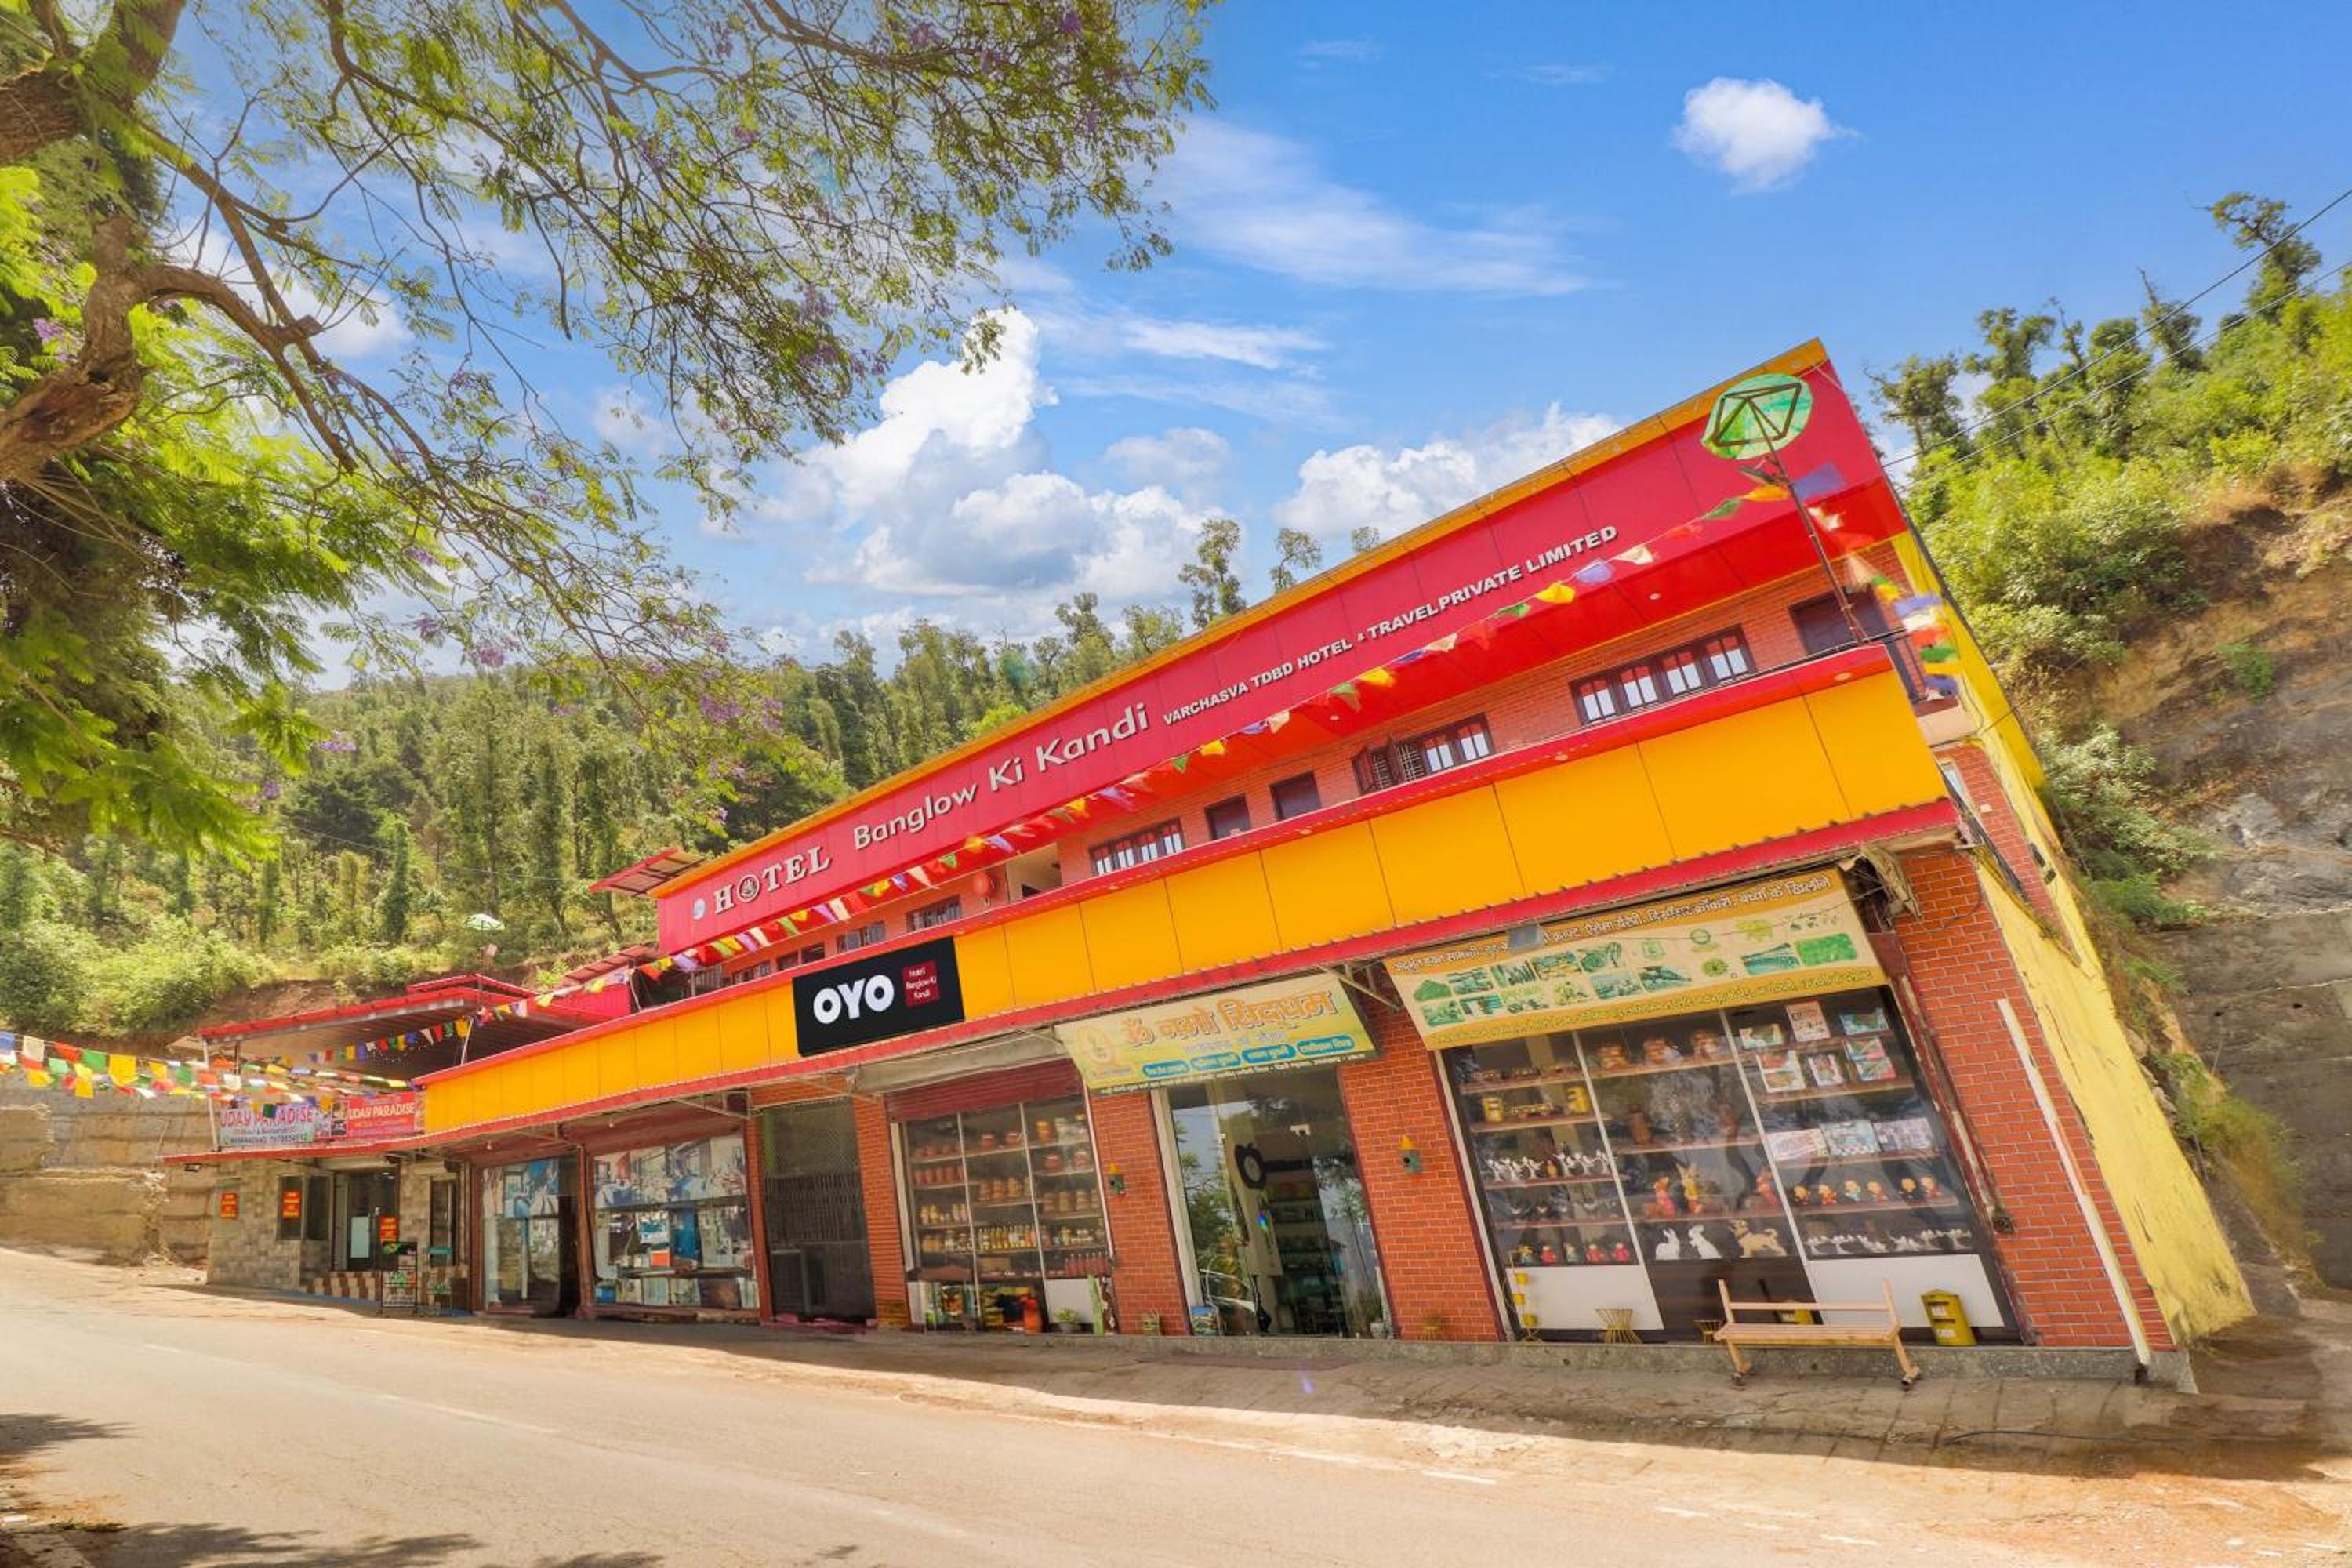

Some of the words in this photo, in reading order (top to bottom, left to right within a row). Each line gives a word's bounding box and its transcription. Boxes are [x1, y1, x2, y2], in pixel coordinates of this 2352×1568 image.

[1163, 682, 1250, 726] VARCHASVA
[1251, 662, 1294, 689] TDBD
[1297, 638, 1353, 670] HOTEL
[1367, 602, 1439, 641] TRAVEL
[1439, 565, 1523, 612] PRIVATE
[1526, 526, 1619, 575] LIMITED
[713, 846, 833, 914] HOTEL
[853, 782, 978, 851] Banglow
[989, 756, 1024, 793] Ki
[1035, 702, 1151, 773] Kandi
[813, 975, 895, 1025] OYO
[372, 1102, 416, 1118] PARADISE
